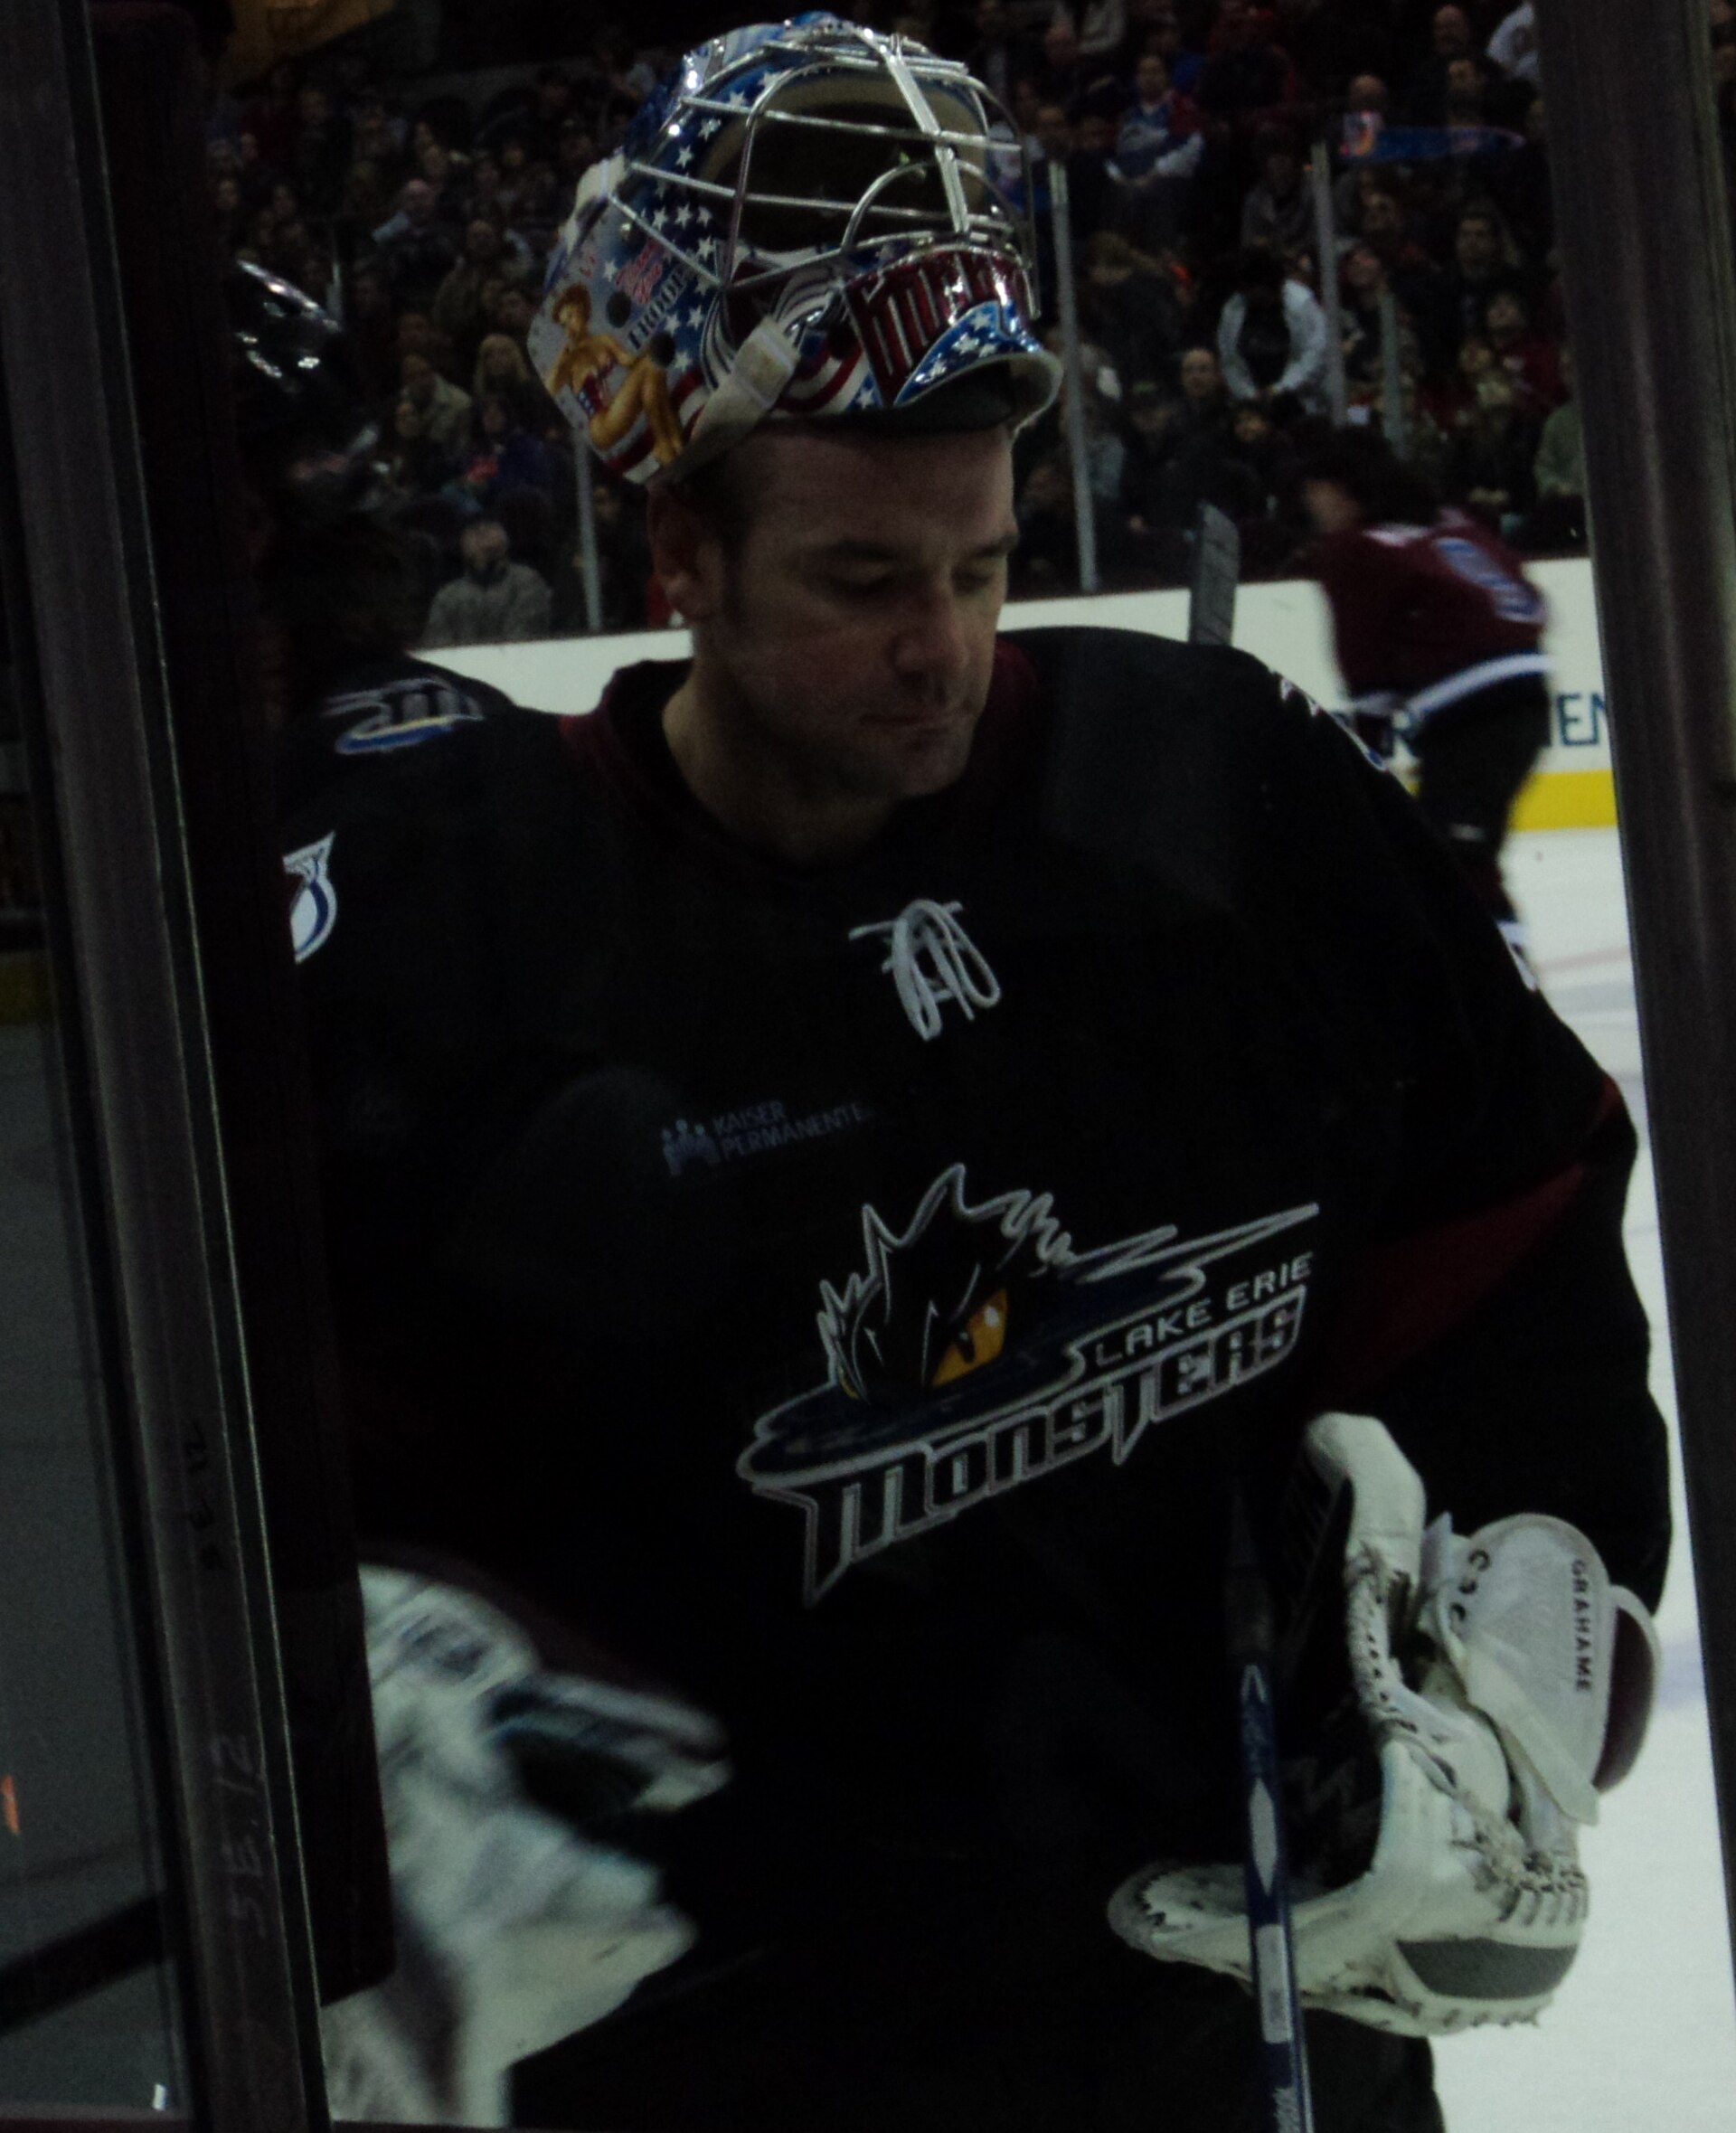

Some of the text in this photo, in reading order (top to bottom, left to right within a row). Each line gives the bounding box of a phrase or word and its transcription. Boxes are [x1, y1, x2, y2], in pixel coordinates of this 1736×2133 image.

[713, 1100, 785, 1137] KAISER
[1095, 1251, 1314, 1368] LAKE ERIE
[1571, 1559, 1591, 1690] GRAHAME
